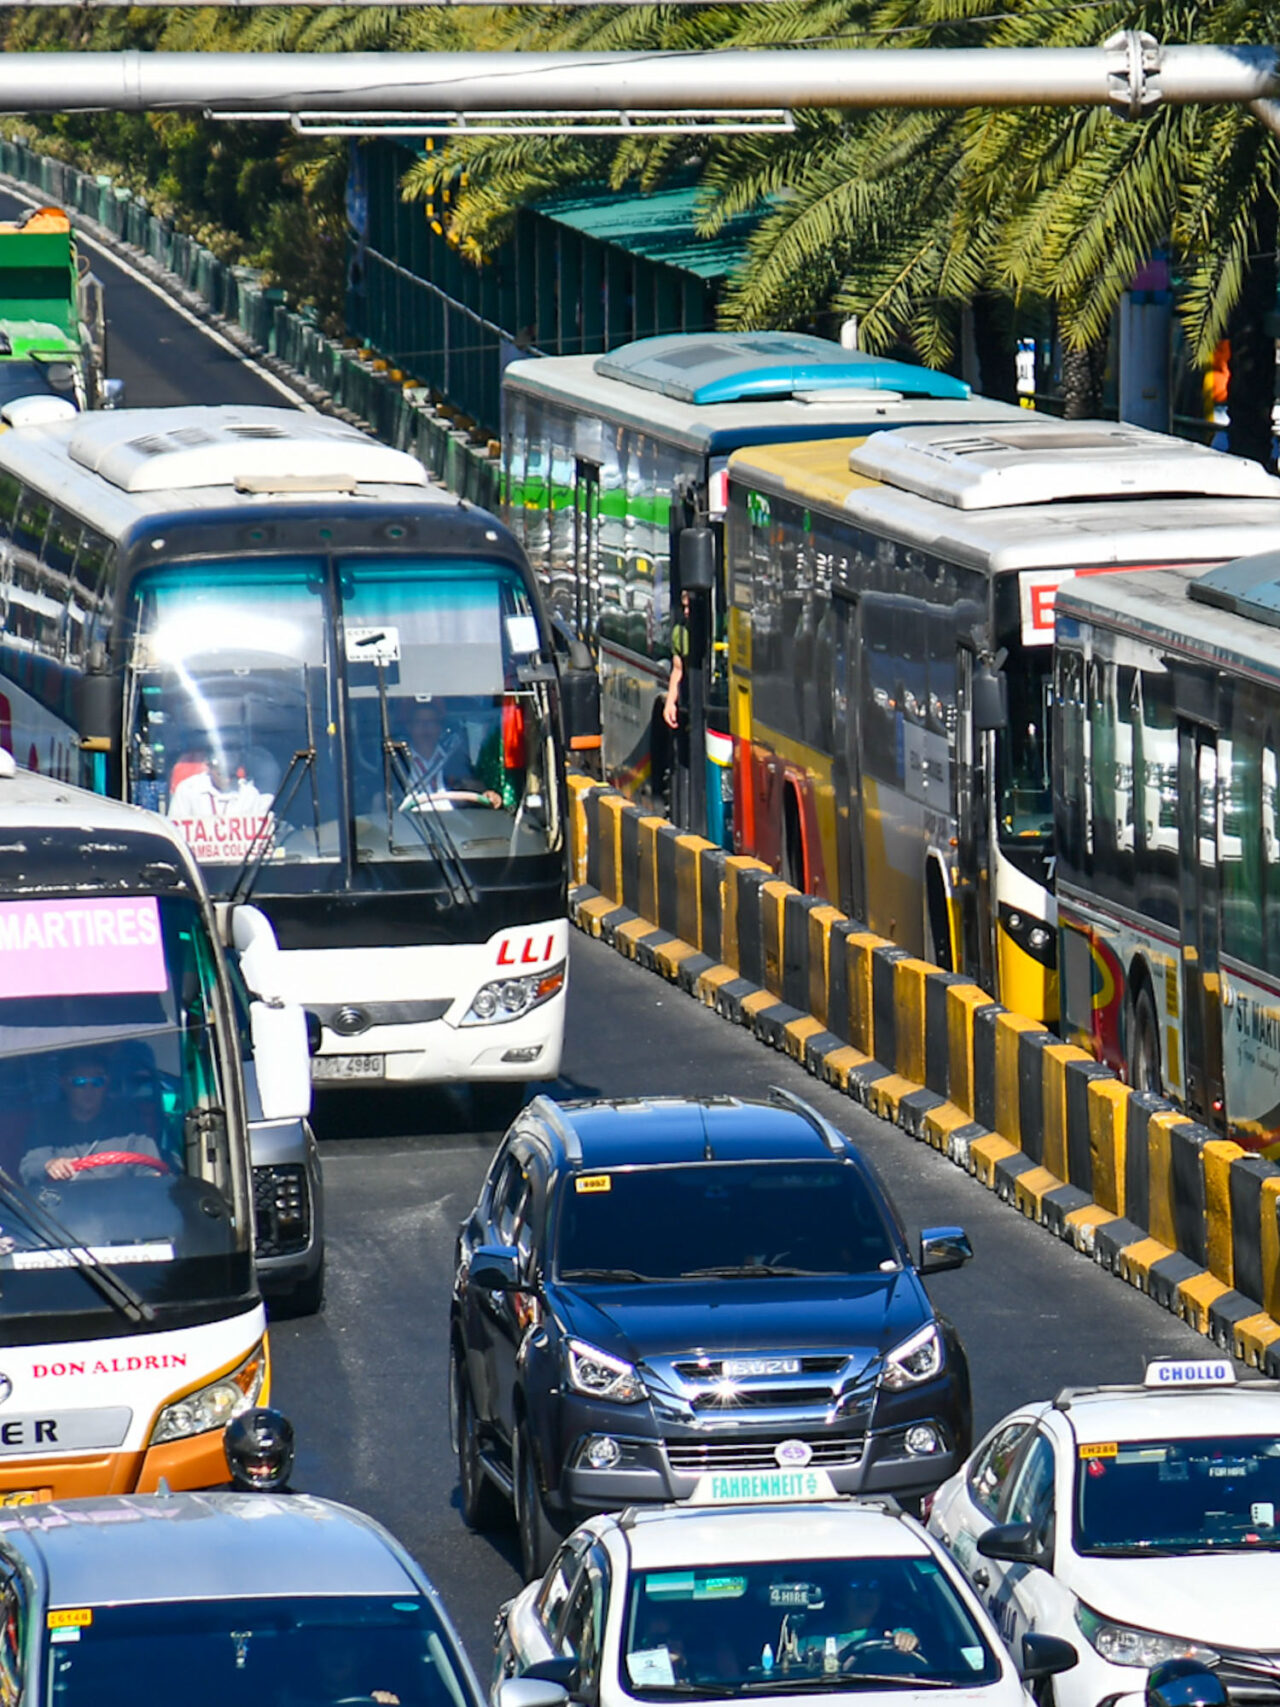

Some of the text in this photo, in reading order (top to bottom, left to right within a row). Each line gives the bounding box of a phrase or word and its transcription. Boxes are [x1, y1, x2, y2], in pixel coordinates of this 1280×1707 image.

[1029, 585, 1057, 629] E
[172, 817, 270, 842] TA.CRUZ
[0, 907, 158, 950] MARTIRES
[496, 935, 555, 966] LLI
[32, 1353, 188, 1378] DON ALDRIN
[1159, 1366, 1226, 1381] CHOLLO
[711, 1473, 804, 1498] FAHRENHEIT
[770, 1588, 809, 1602] 4 HIRE
